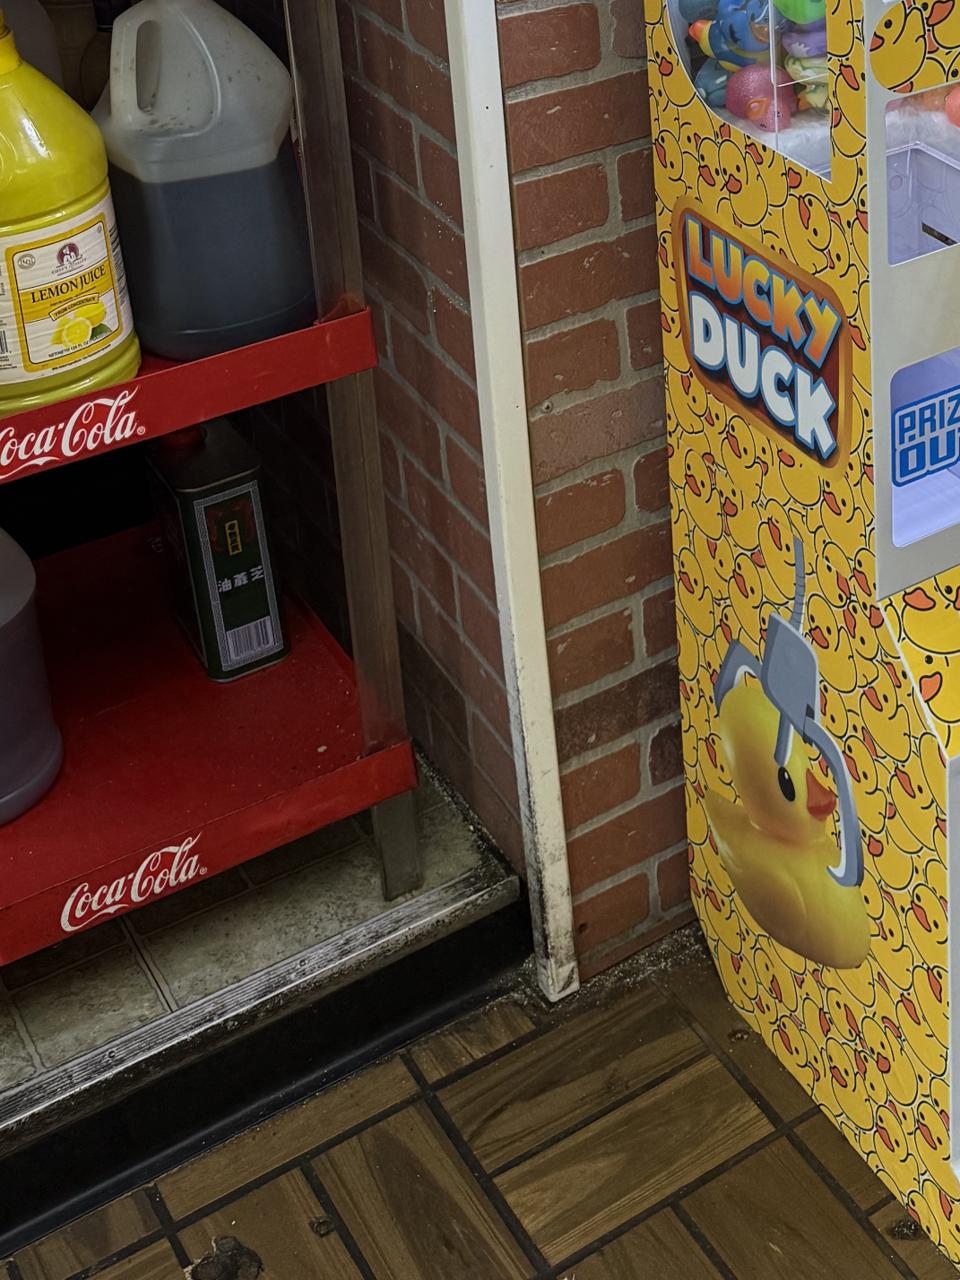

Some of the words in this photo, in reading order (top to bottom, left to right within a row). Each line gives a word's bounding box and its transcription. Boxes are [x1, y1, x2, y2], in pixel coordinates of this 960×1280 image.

[31, 278, 79, 303] LEMON
[79, 264, 106, 290] JUICE
[684, 214, 842, 368] LUCKY
[689, 290, 837, 459] DUCK
[60, 832, 202, 932] Coca-Cola
